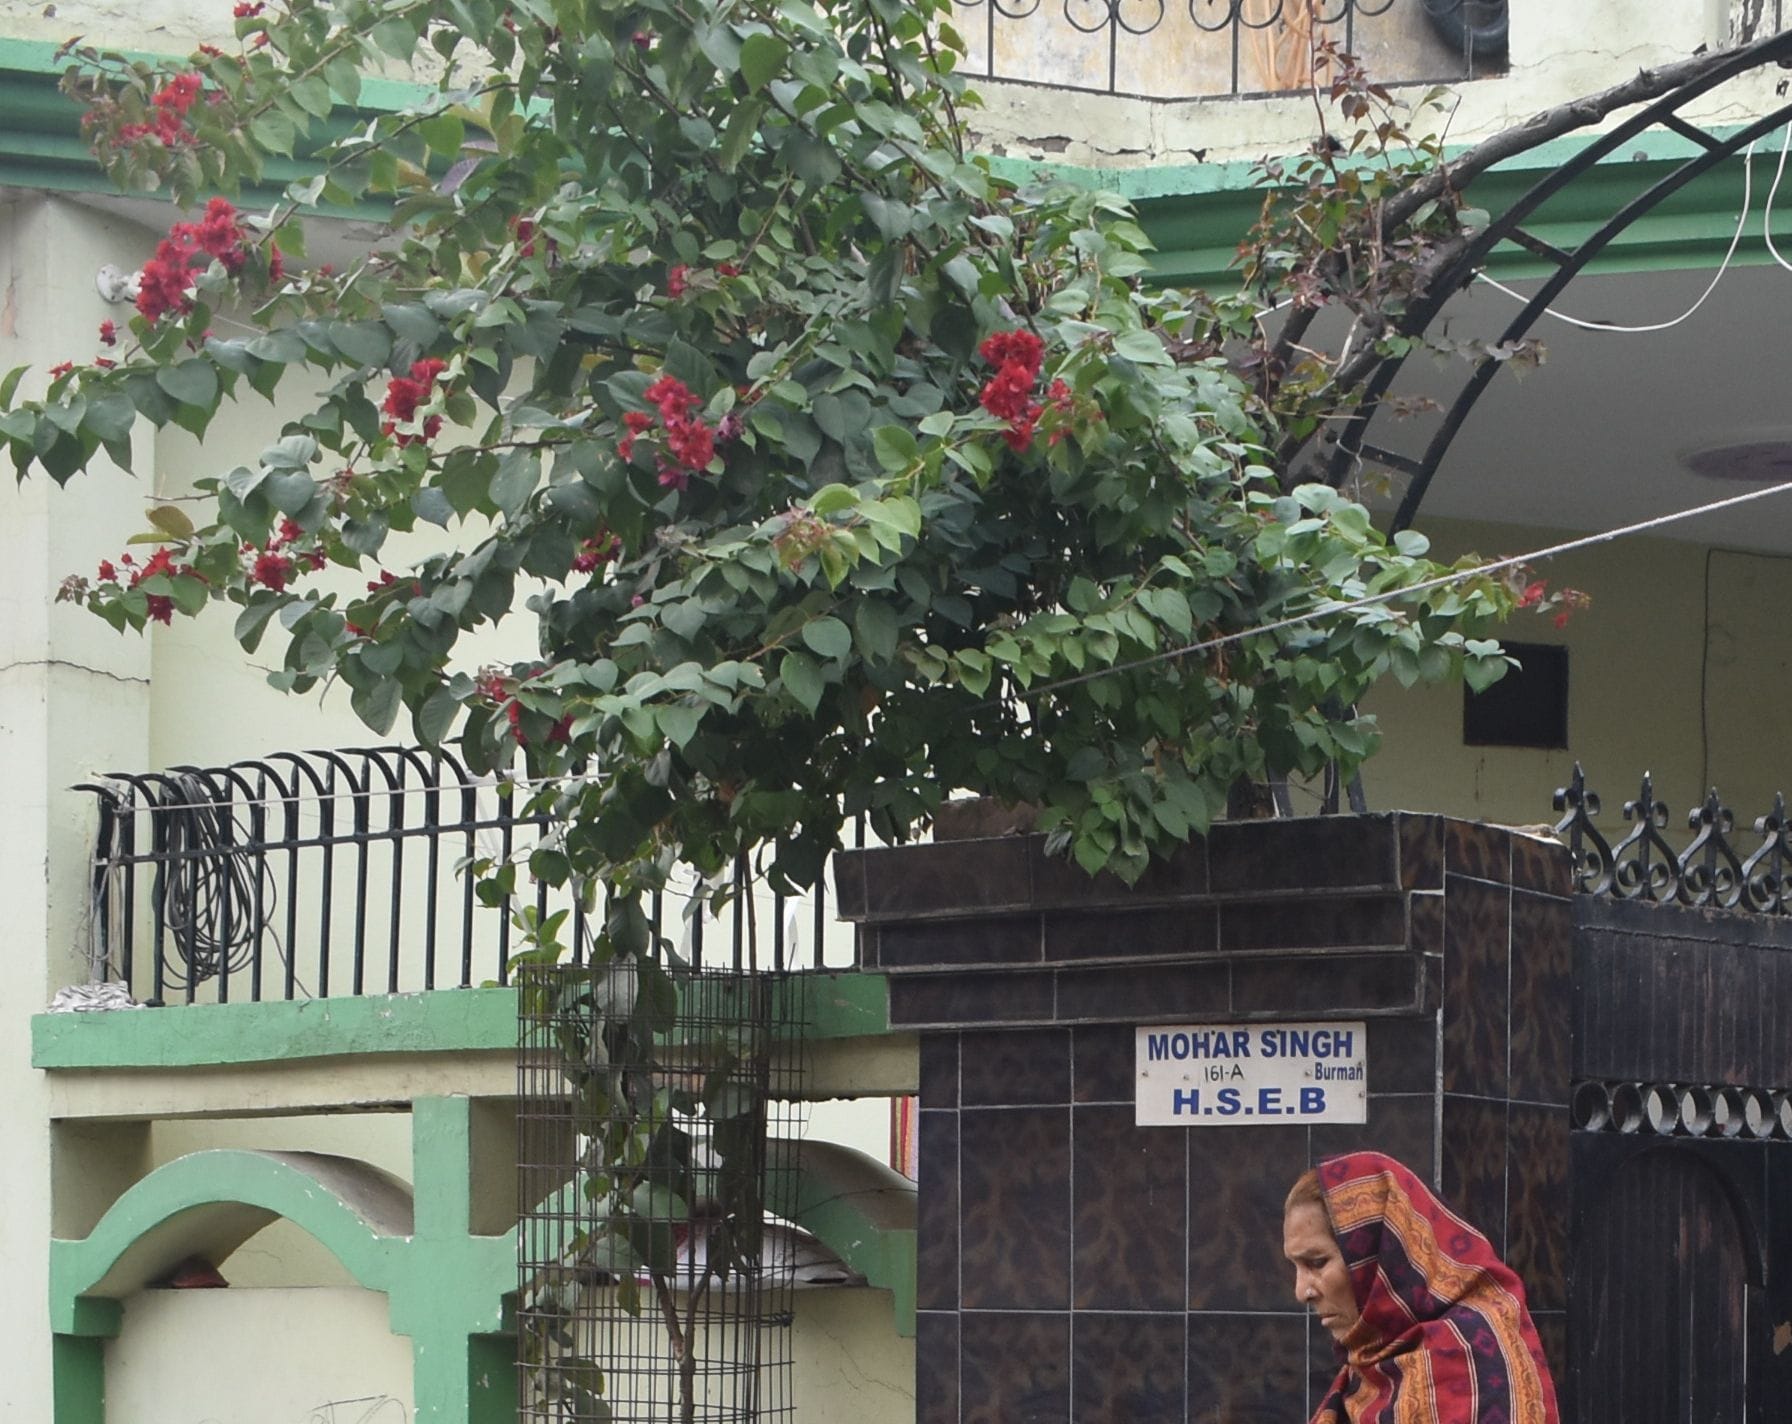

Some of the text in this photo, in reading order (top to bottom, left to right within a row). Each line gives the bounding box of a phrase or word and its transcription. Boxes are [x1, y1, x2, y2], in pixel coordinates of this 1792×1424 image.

[1148, 1030, 1353, 1061] MOHAR SINGH
[1204, 1063, 1244, 1083] 161-A
[1314, 1062, 1364, 1081] Burman
[1173, 1087, 1326, 1115] H.S.E.B
